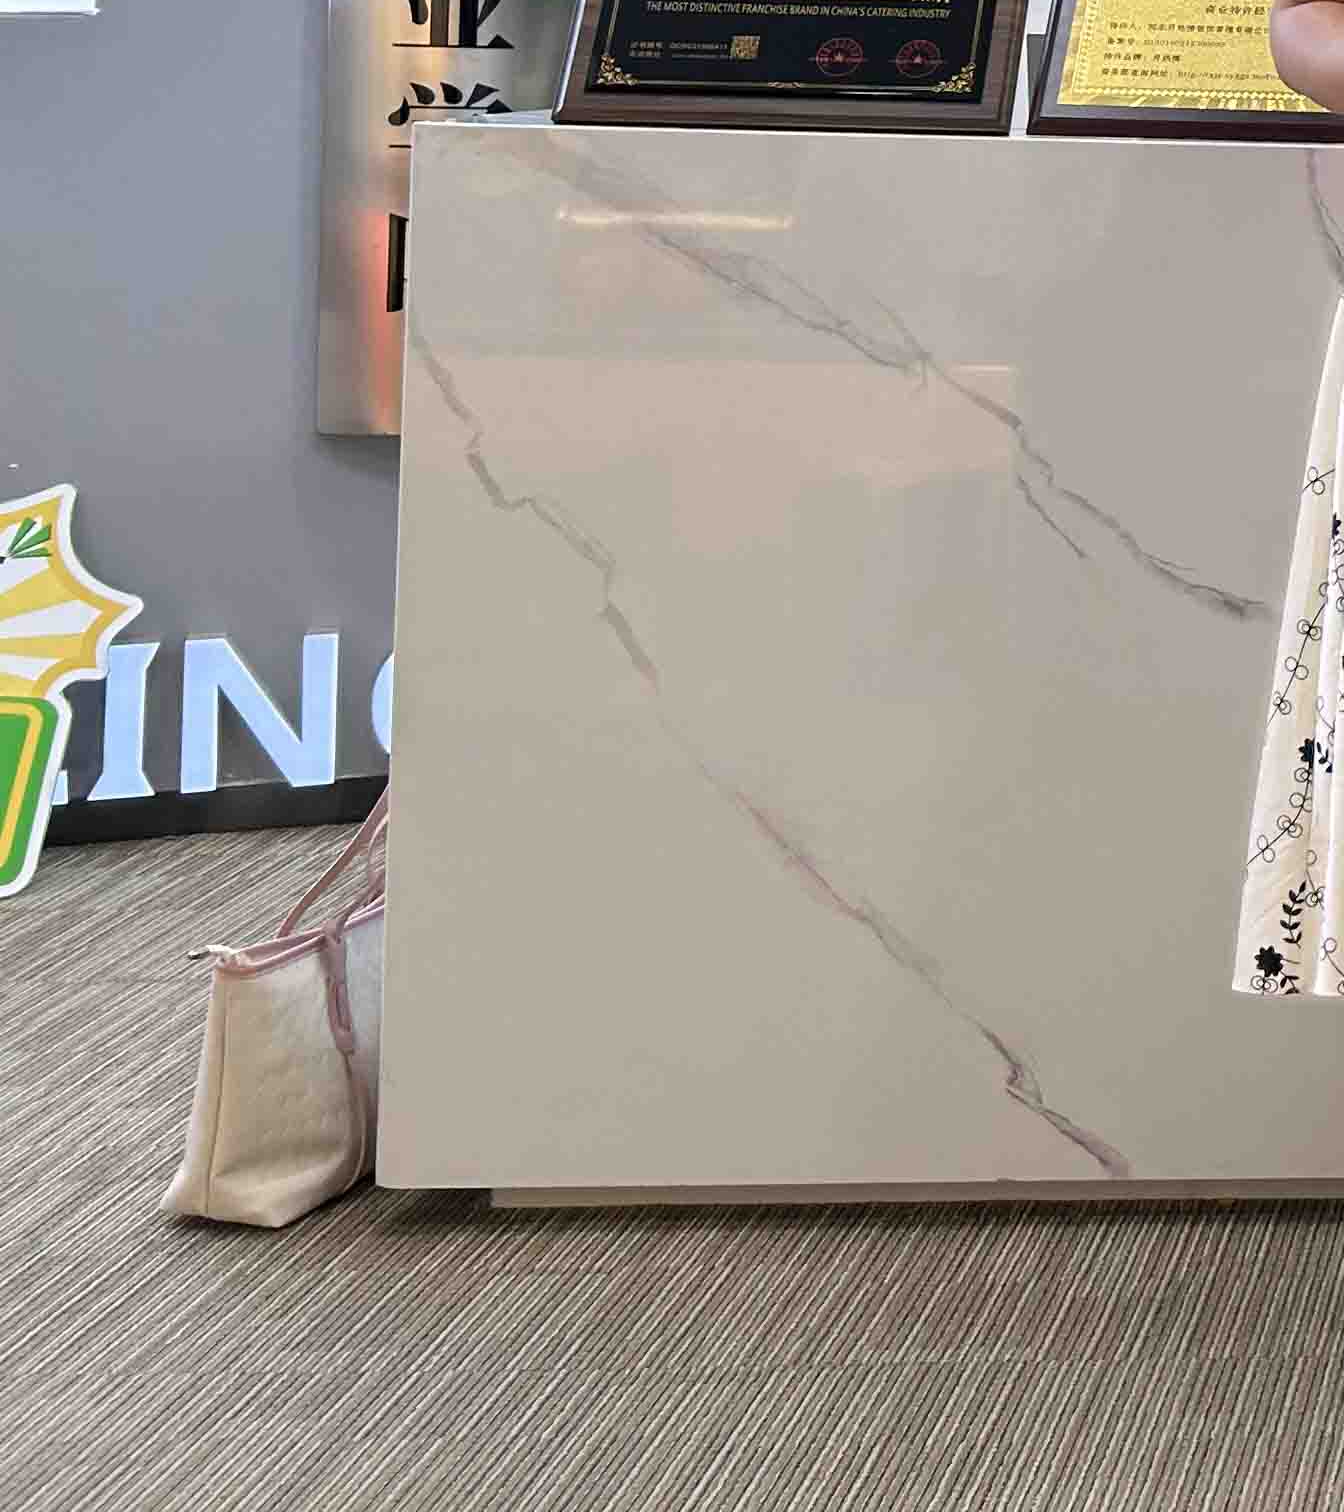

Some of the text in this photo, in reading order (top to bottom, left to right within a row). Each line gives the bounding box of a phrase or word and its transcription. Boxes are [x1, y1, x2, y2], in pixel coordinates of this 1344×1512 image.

[647, 0, 662, 12] THE
[664, 1, 688, 12] MOST
[689, 2, 741, 14] DISTINCTIVE
[742, 3, 788, 15] FRANCHISE
[789, 5, 819, 16] BRAND
[831, 6, 865, 17] CHINA'S
[867, 7, 909, 18] CATERING
[910, 8, 951, 19] INDUSTRY
[52, 633, 394, 805] IN
